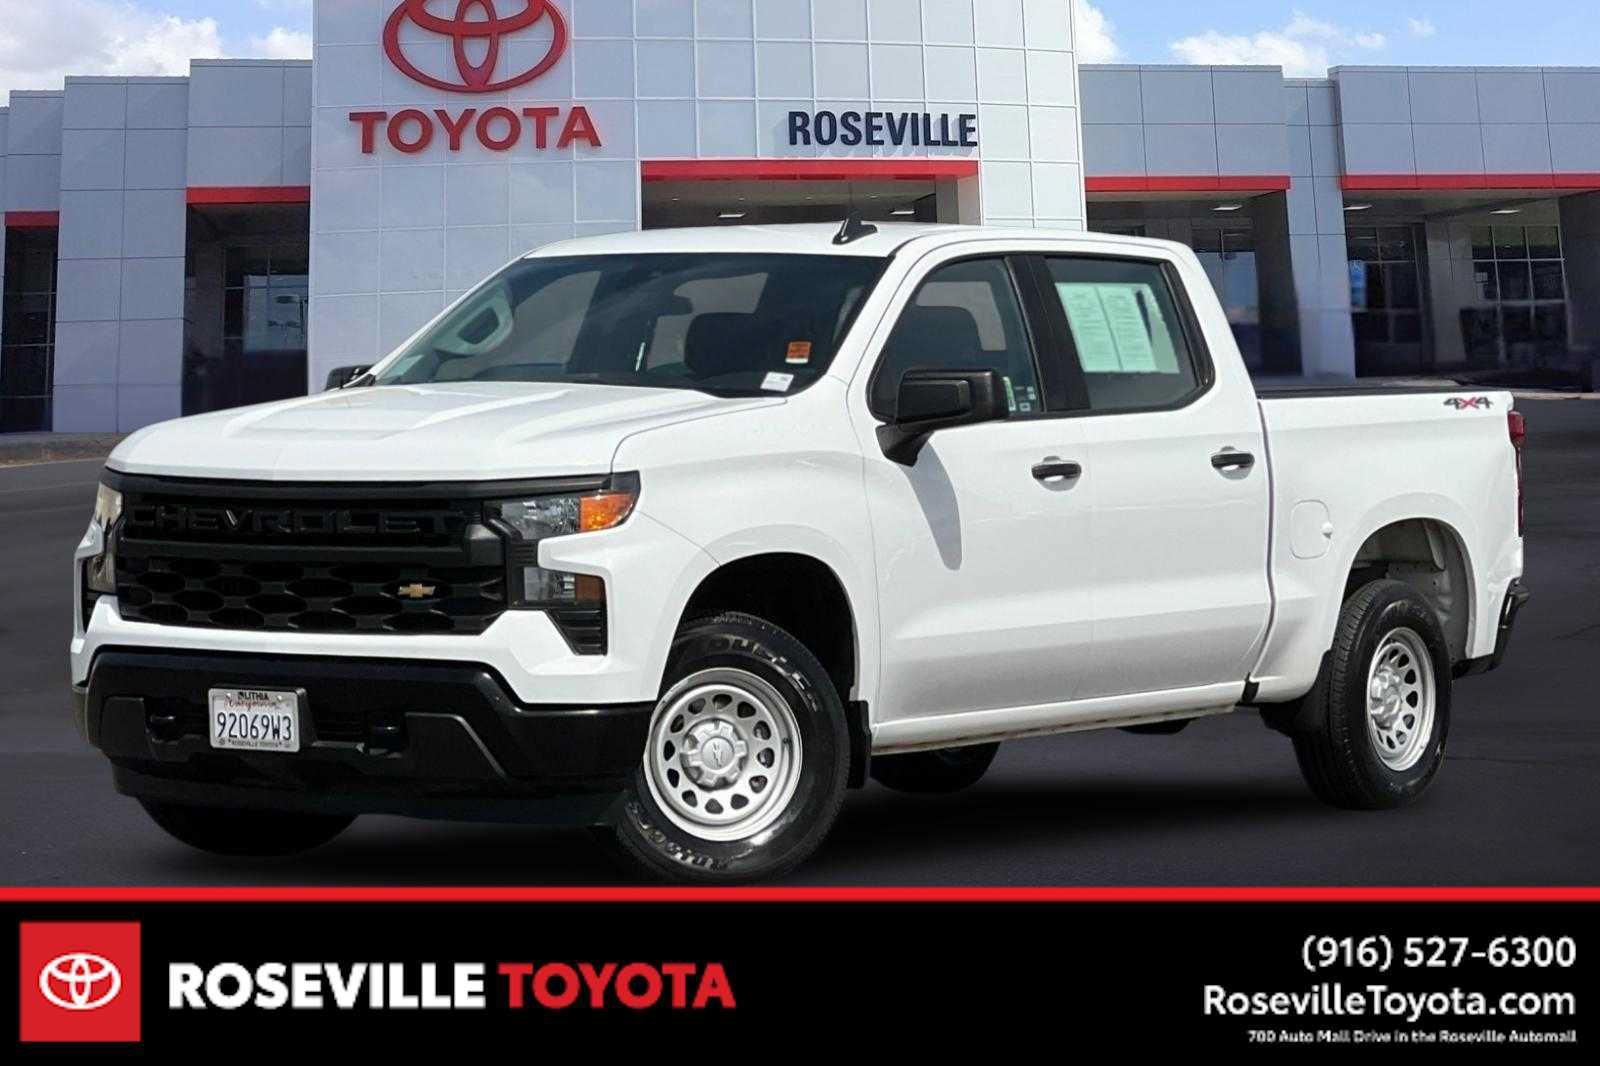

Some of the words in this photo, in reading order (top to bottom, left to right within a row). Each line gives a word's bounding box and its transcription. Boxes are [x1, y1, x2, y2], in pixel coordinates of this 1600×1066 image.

[349, 106, 602, 154] TOYOTA
[788, 111, 978, 147] ROSEVILLE
[131, 503, 466, 534] CHEVROLET
[217, 712, 292, 741] 92069W3
